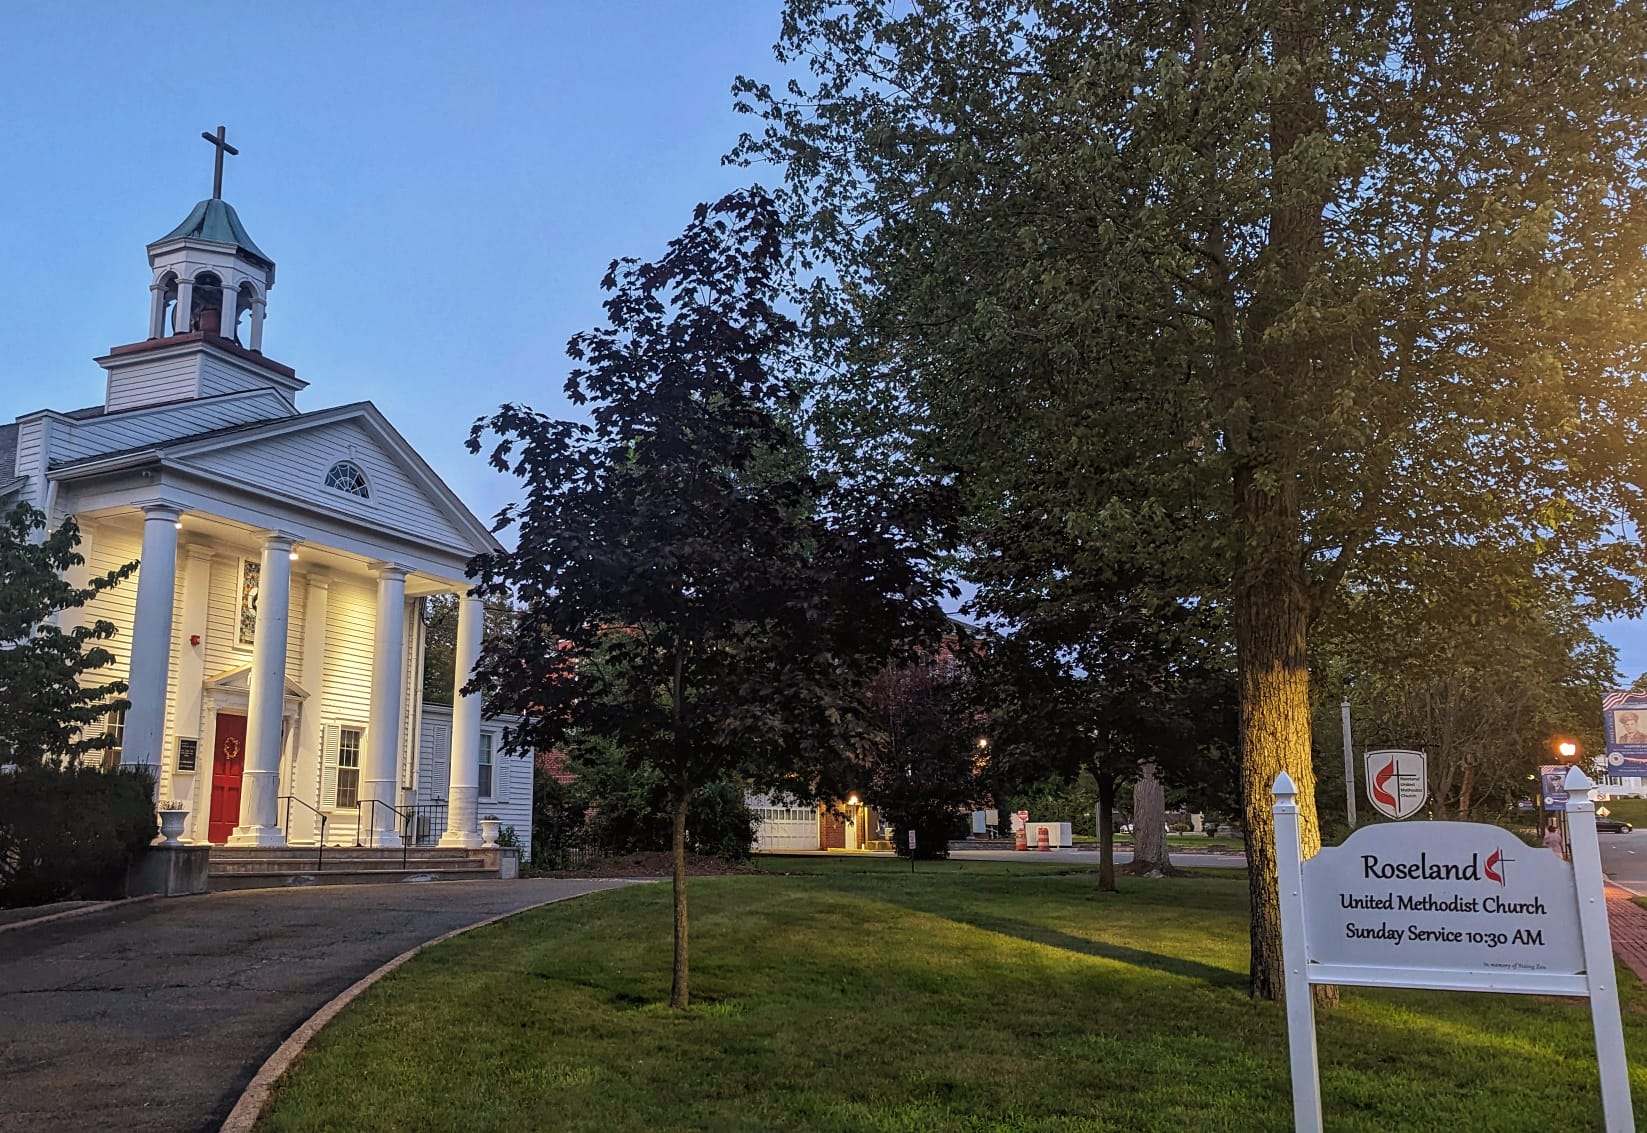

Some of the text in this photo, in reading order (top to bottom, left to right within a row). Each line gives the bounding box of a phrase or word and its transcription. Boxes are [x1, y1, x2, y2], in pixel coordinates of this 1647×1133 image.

[1361, 852, 1481, 881] Roseland
[1340, 893, 1547, 915] United Methodist Church
[1346, 922, 1545, 948] Sunday Service 10:30 AM
